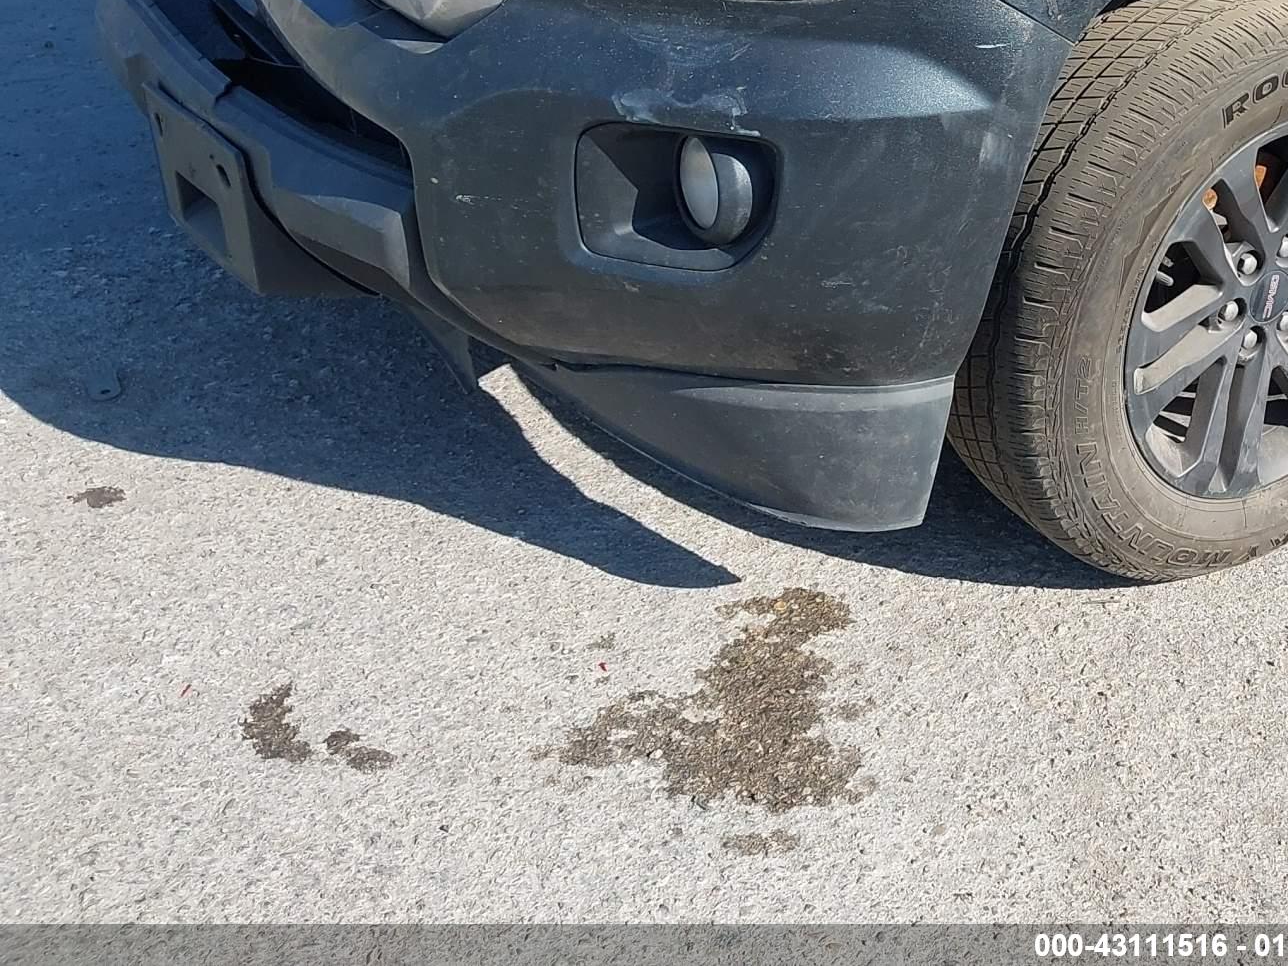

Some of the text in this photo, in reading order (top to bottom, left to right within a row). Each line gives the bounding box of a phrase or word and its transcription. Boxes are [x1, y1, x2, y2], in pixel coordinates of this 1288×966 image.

[1263, 274, 1280, 319] GMC
[1074, 355, 1092, 435] H/T2
[1075, 441, 1233, 567] MOUNTAIN
